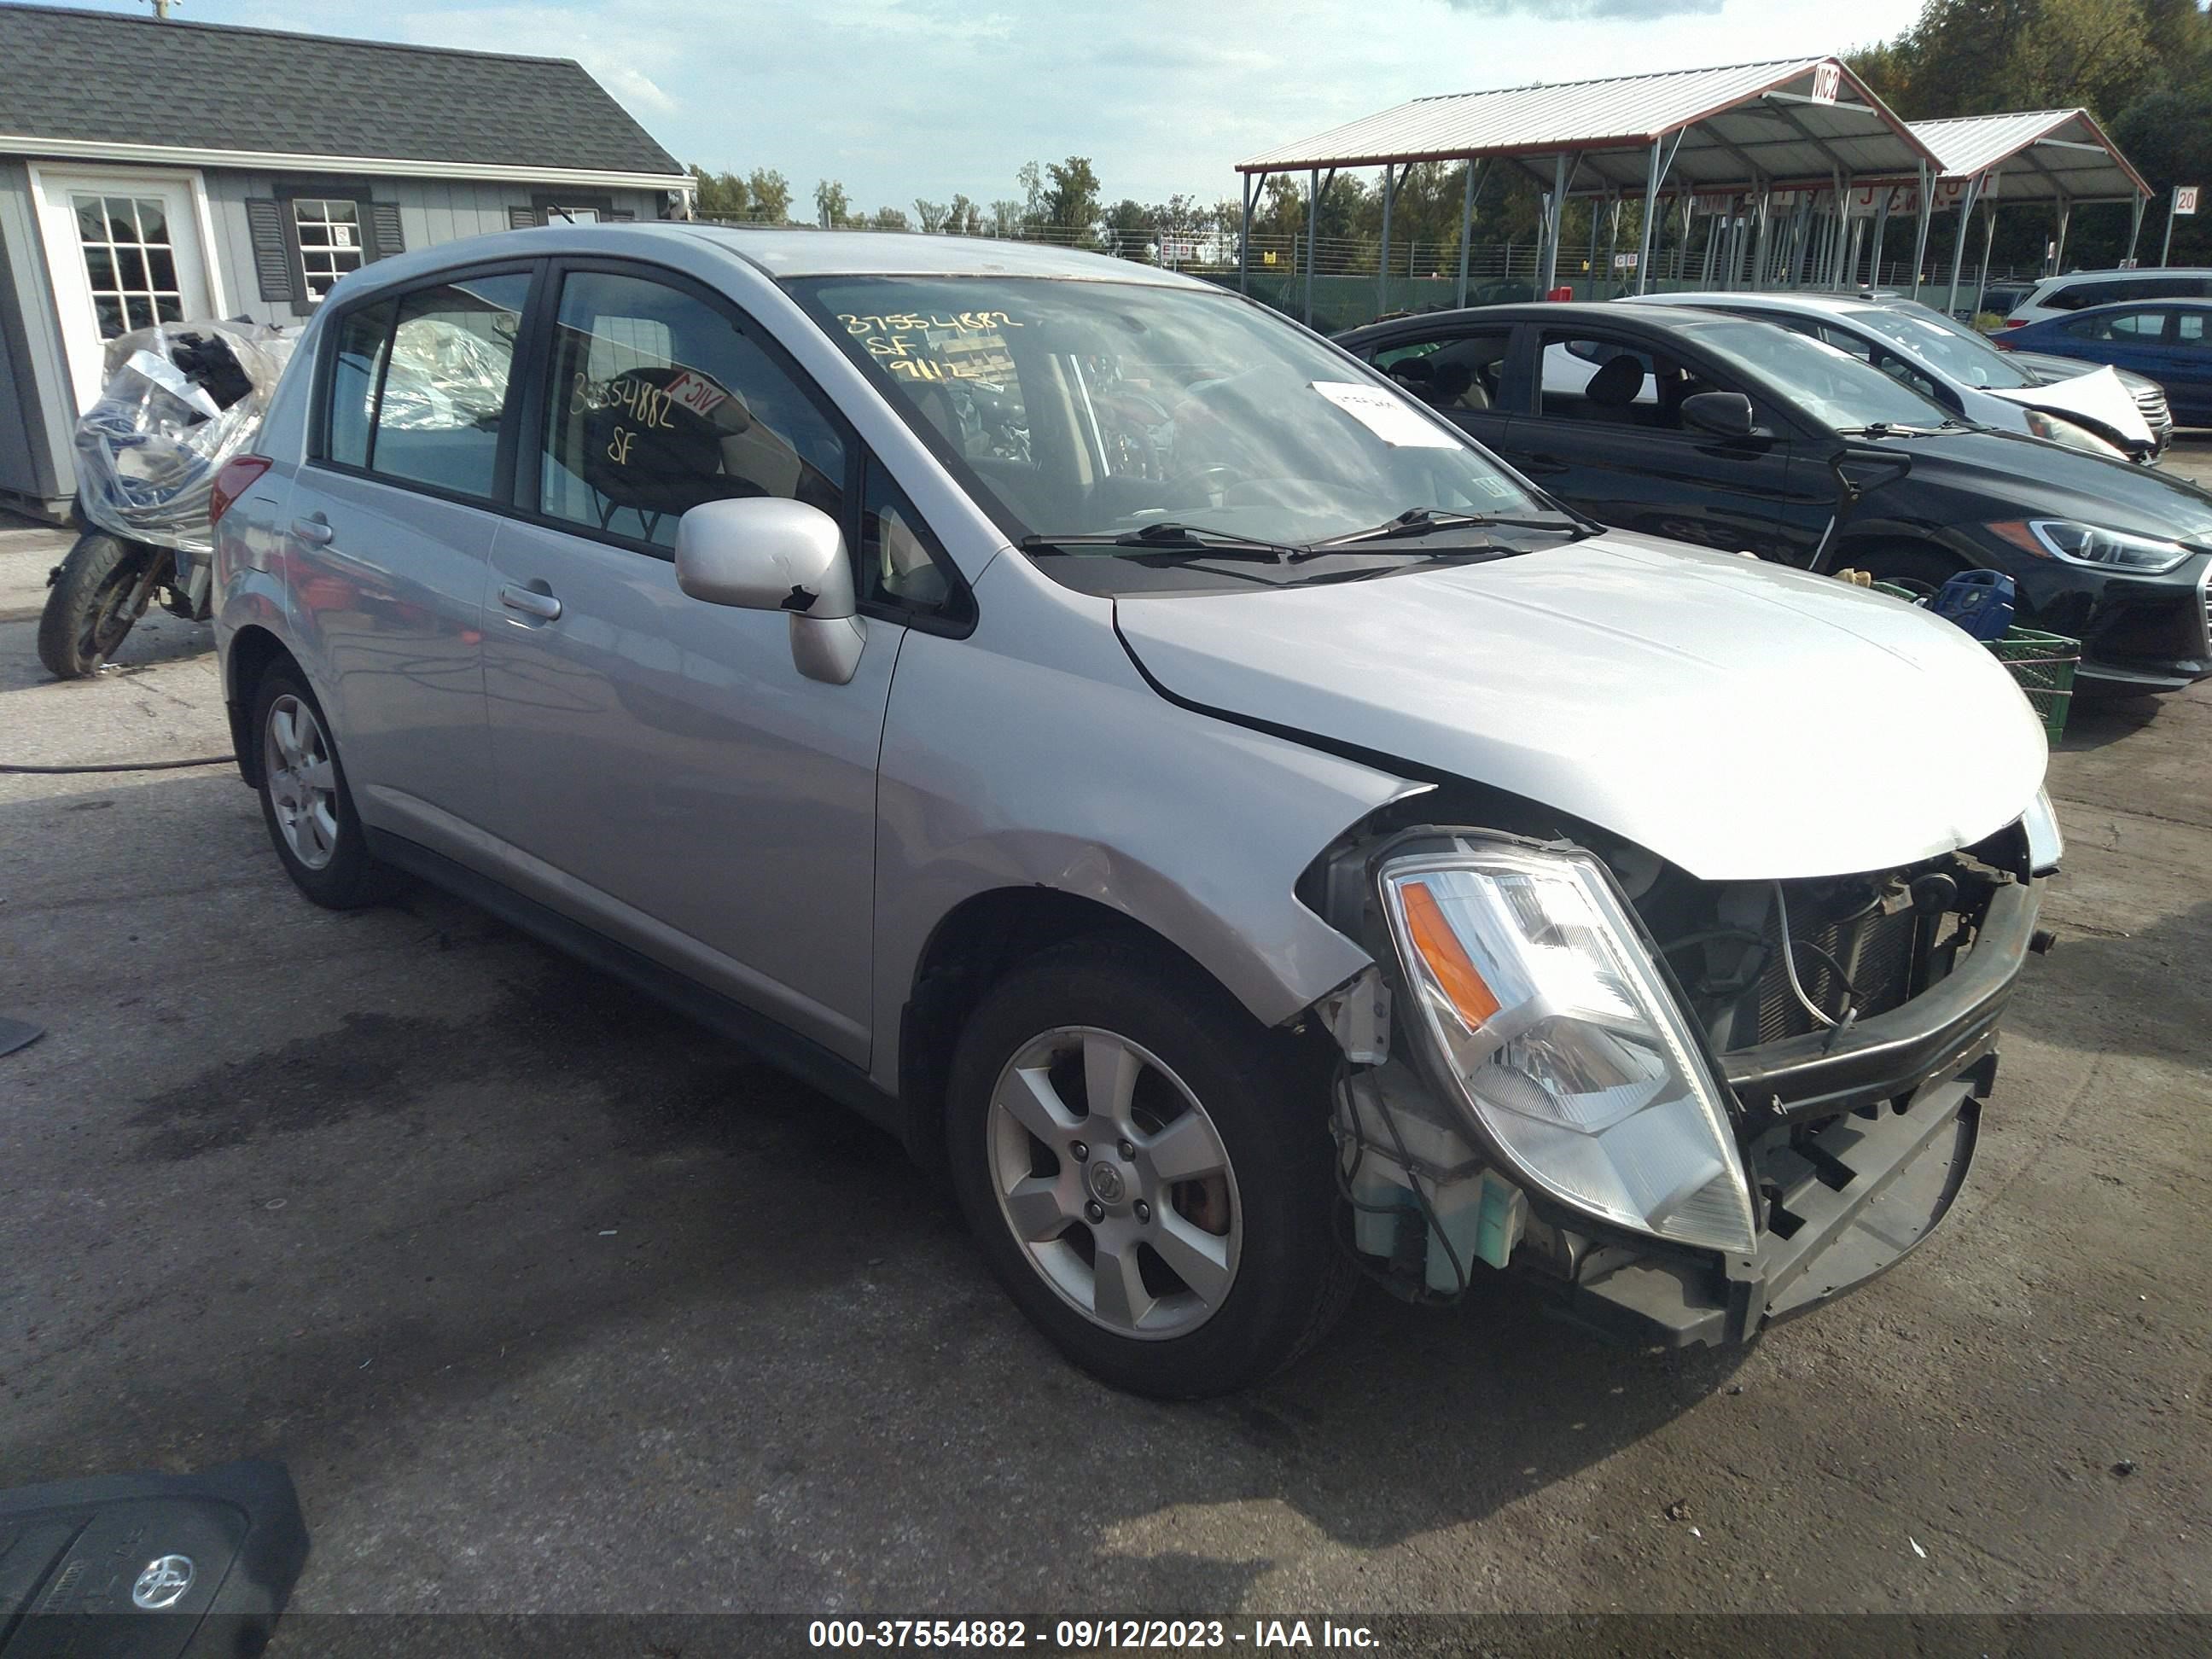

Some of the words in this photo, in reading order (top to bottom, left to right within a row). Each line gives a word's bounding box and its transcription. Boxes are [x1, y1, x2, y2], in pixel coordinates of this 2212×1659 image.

[1815, 67, 1831, 99] VIC
[1829, 71, 1838, 100] 2
[2177, 192, 2194, 209] 20
[837, 312, 1024, 334] 37554882
[866, 335, 917, 356] SF
[608, 426, 637, 465] SF
